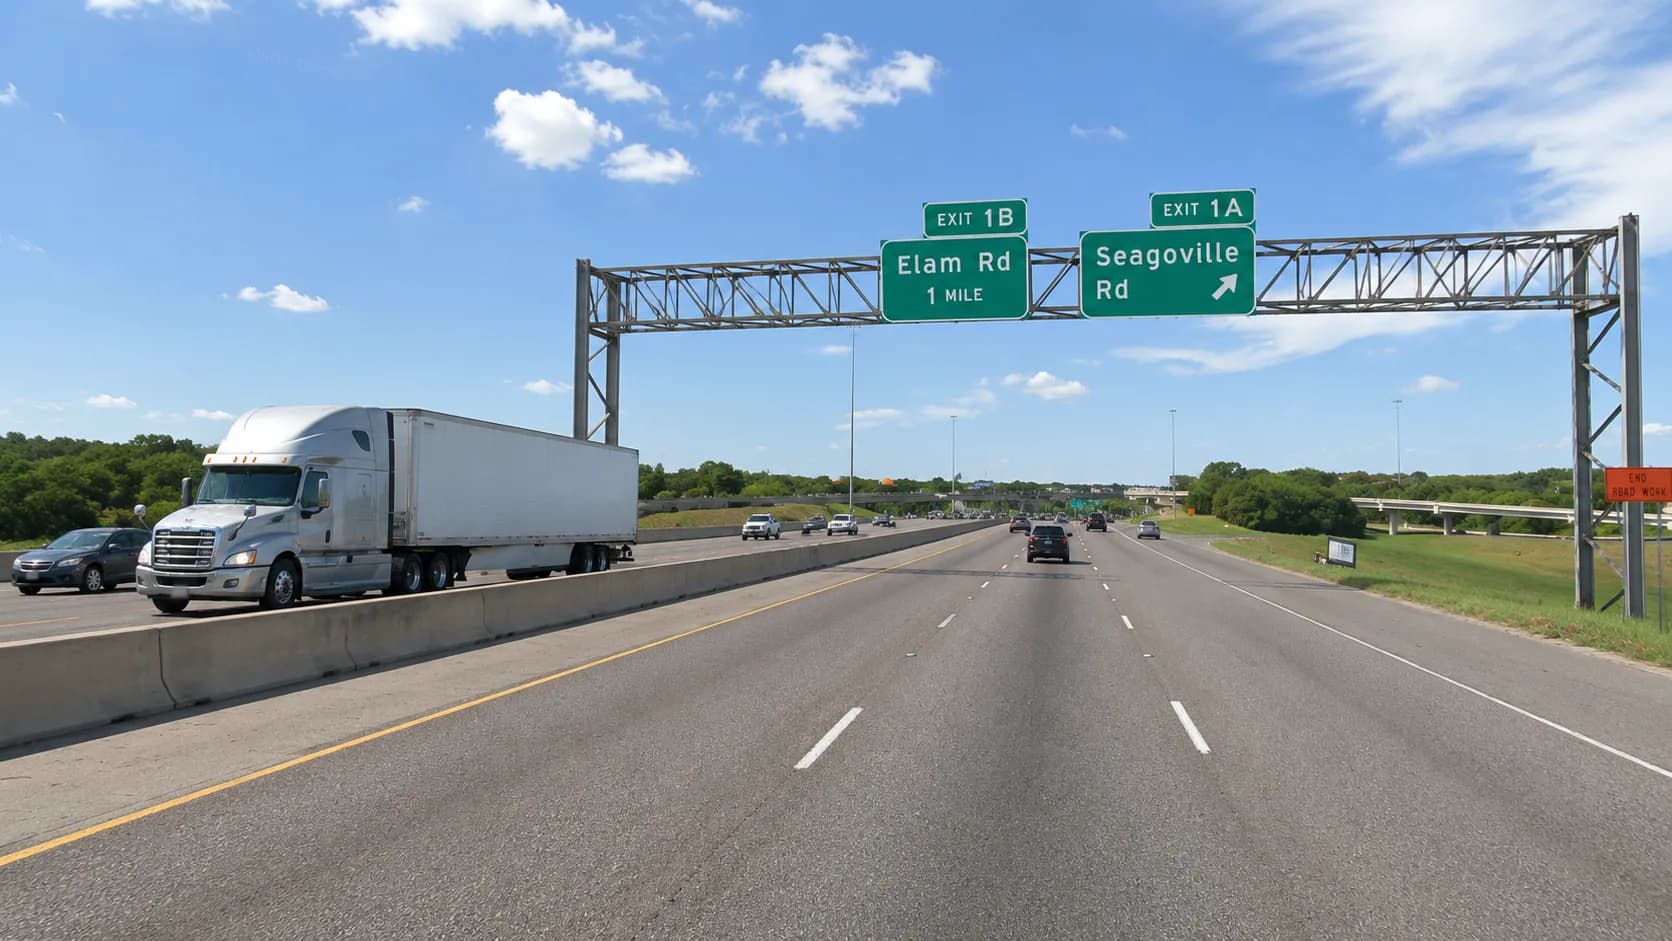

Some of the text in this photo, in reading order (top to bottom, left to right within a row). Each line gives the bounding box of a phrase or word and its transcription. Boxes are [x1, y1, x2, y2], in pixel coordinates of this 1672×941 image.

[937, 207, 1014, 227] EXIT 1B
[1163, 197, 1243, 218] EXIT 1A
[898, 251, 1011, 275] Elam Rd
[1096, 242, 1240, 271] Seagoville
[926, 287, 983, 305] 1 MILE
[1096, 279, 1129, 300] Rd
[1629, 472, 1647, 484] END
